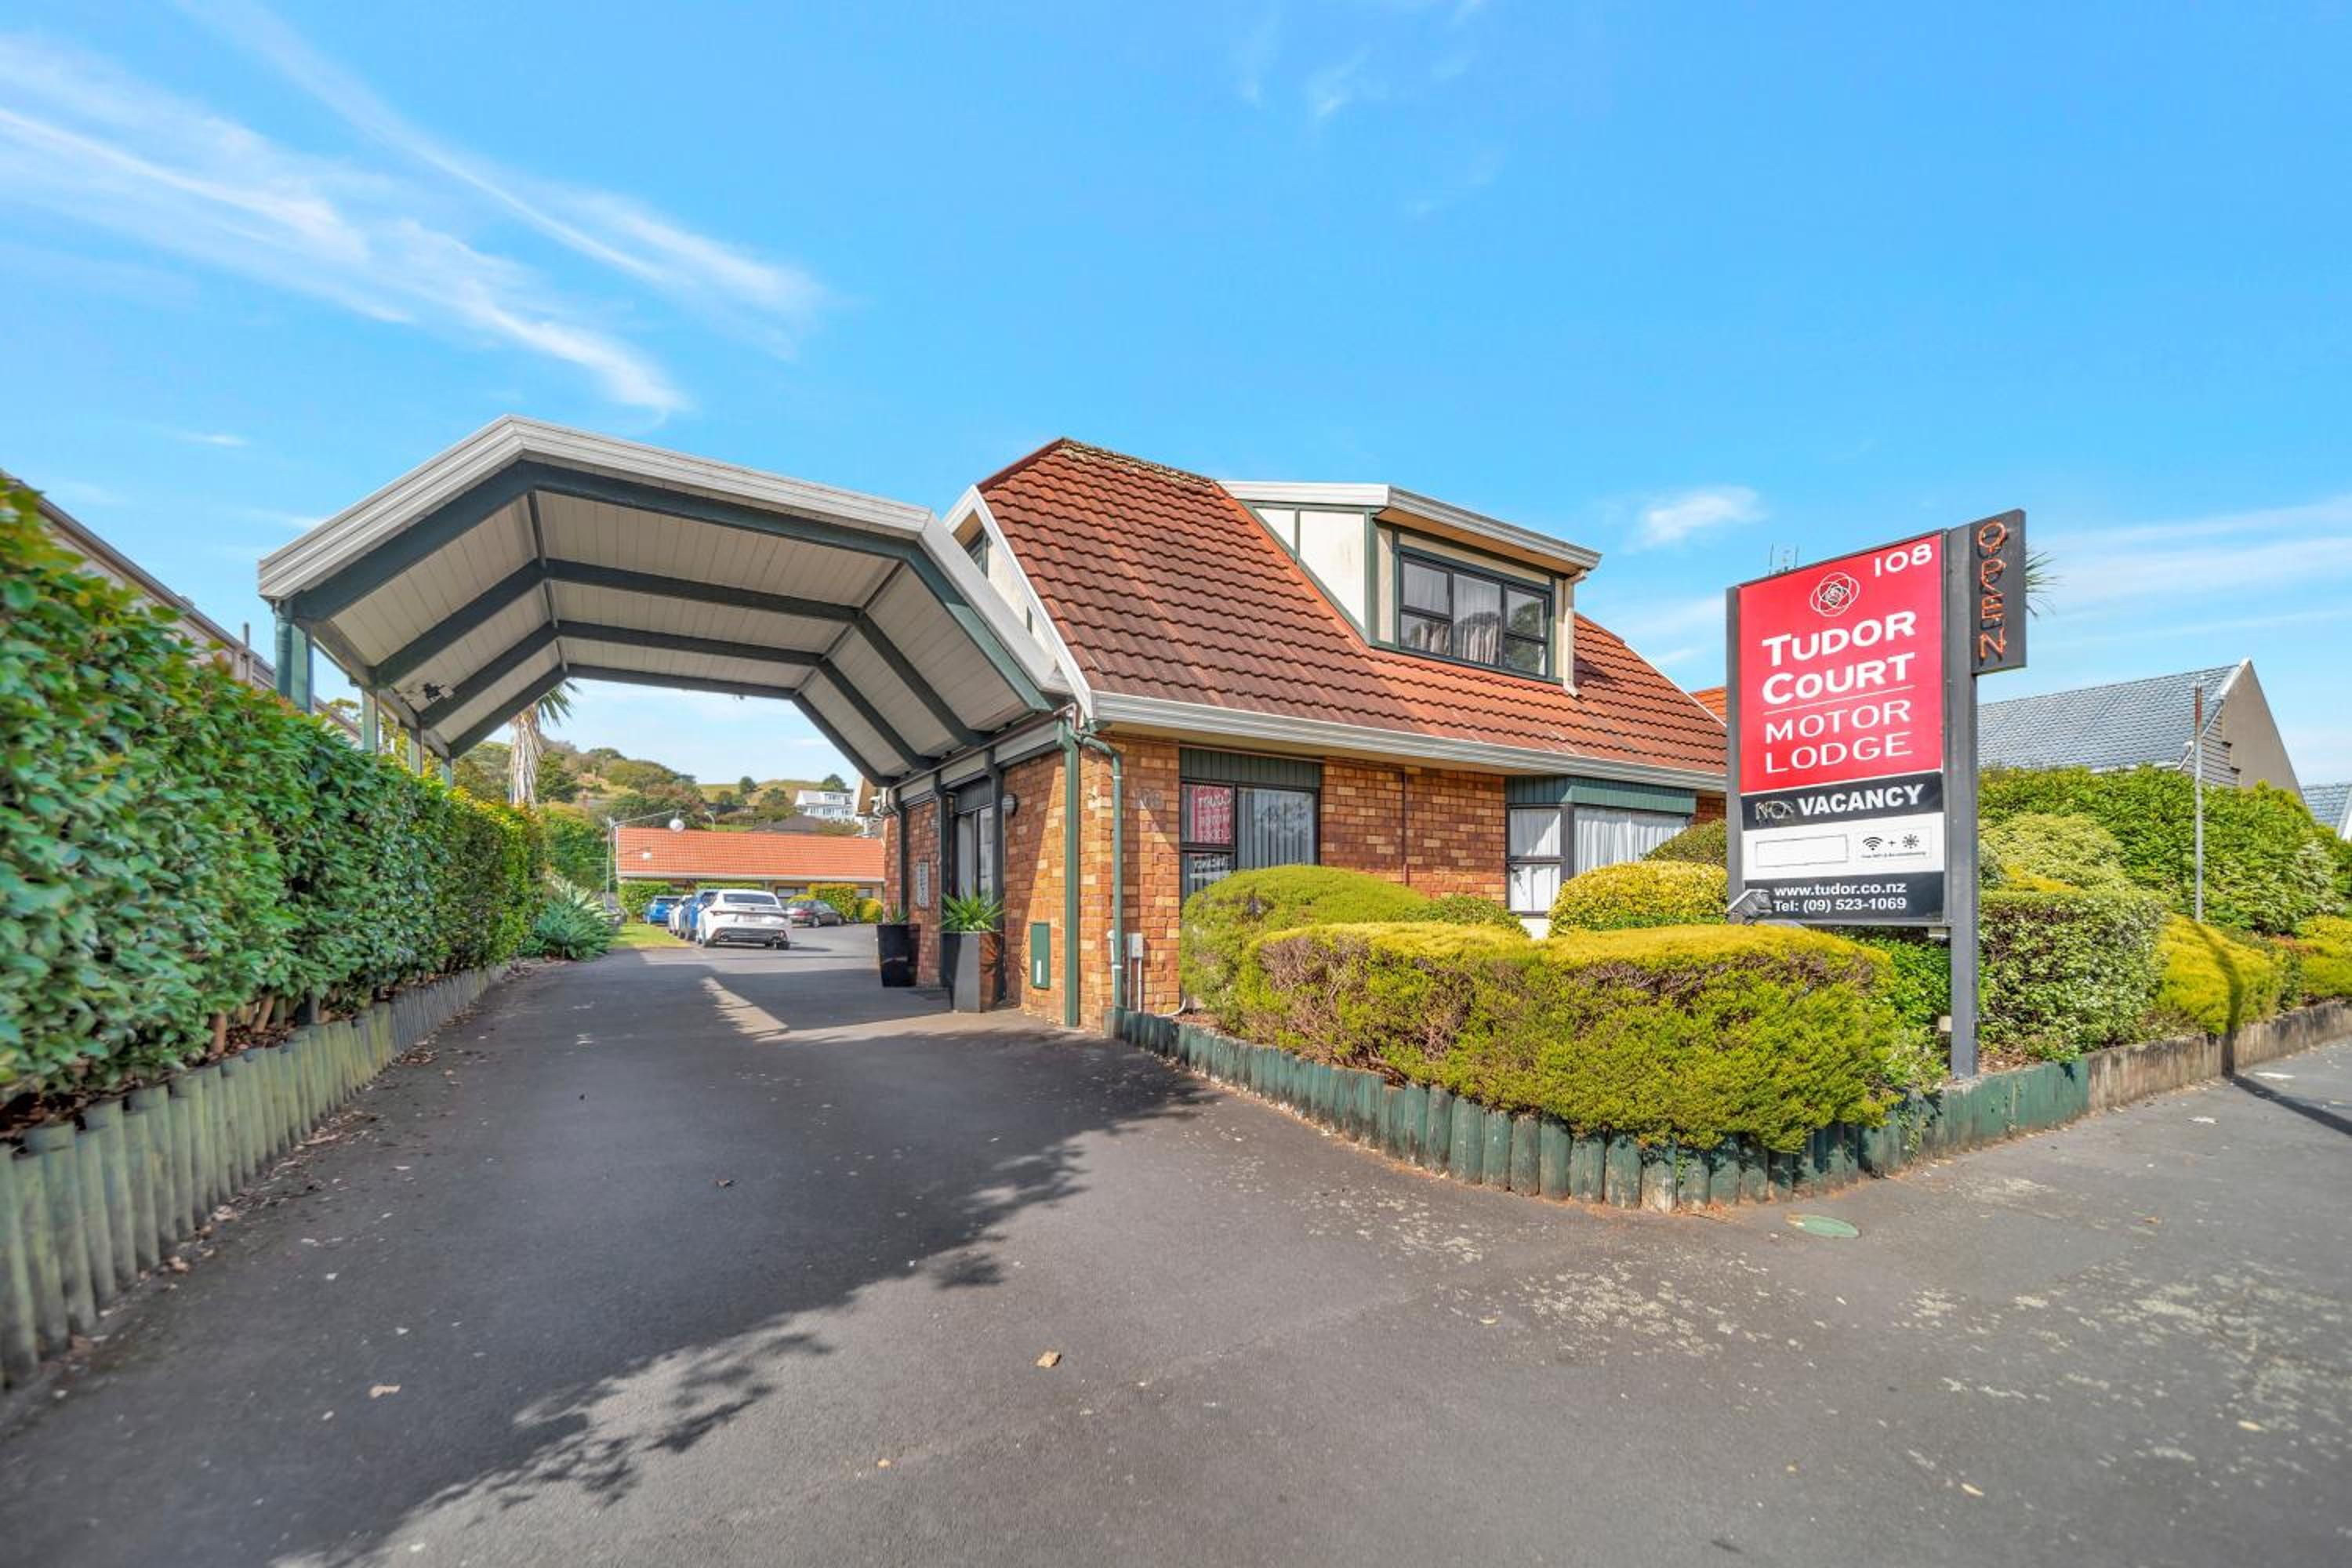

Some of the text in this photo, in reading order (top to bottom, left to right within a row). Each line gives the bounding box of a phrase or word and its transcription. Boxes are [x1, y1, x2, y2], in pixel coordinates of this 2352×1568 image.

[1874, 543, 1933, 577] 108
[1978, 521, 2007, 659] OPEN
[1762, 611, 1916, 666] TUDOR
[1762, 652, 1915, 704] COURT
[1766, 699, 1911, 744] MOTOR
[1766, 732, 1912, 774] LODGE
[1798, 784, 1924, 816] VACANCY
[1773, 898, 1907, 913] Tel: (09) 523-1069
[1774, 882, 1907, 897] www.tudor.co.nz
